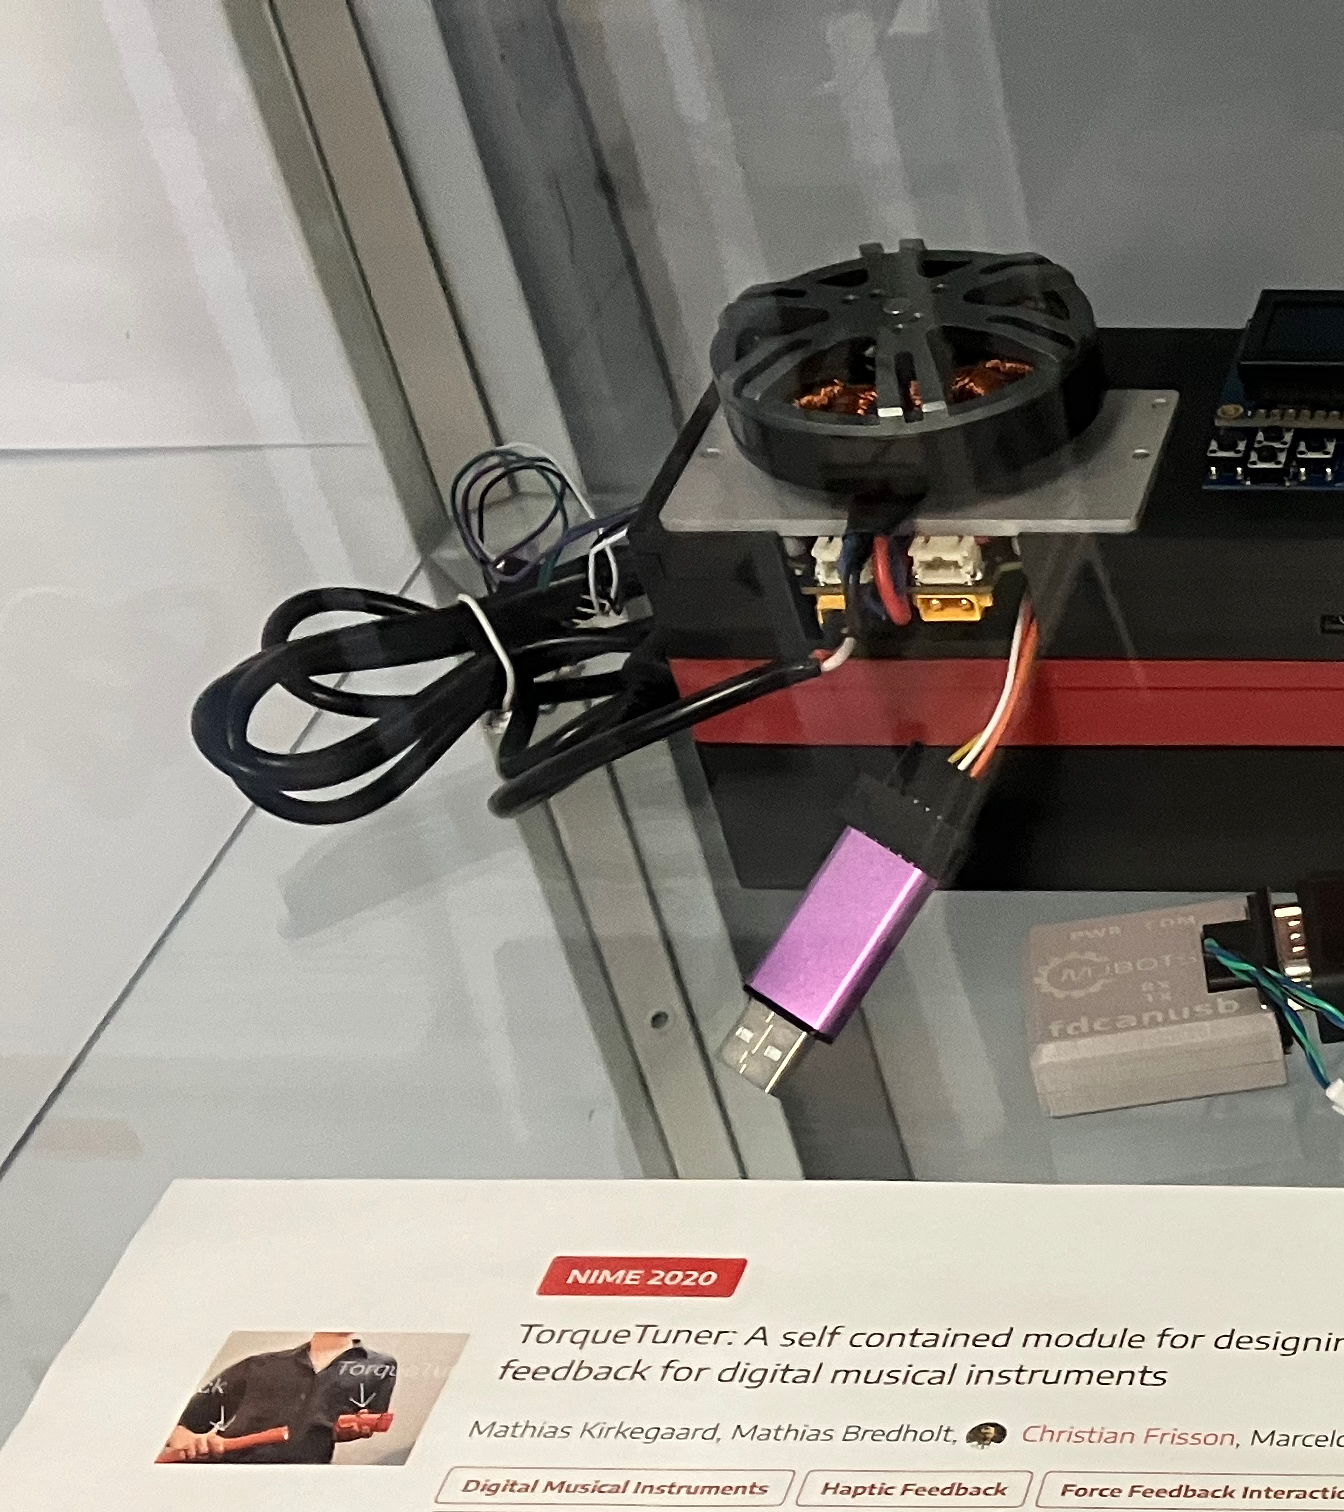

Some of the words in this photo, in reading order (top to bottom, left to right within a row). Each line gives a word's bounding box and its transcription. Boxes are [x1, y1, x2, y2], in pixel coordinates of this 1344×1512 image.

[1049, 998, 1240, 1038] fdcanusb
[566, 1269, 643, 1286] NIME
[647, 1269, 717, 1287] 2020
[519, 1324, 737, 1349] TorqueTuner:
[744, 1326, 769, 1346] A
[779, 1326, 842, 1348] self
[850, 1327, 1010, 1350] contained
[1021, 1327, 1145, 1350] module
[1157, 1328, 1205, 1350] for
[498, 1360, 648, 1382] feedback
[659, 1360, 703, 1382] for
[717, 1360, 822, 1389] digital
[829, 1363, 955, 1386] musical
[965, 1364, 1168, 1388] instruments
[469, 1421, 572, 1440] Mathias
[580, 1421, 722, 1445] Kirkegaard,
[732, 1422, 833, 1442] Mathias
[841, 1423, 958, 1446] Bredholt,
[1022, 1426, 1136, 1446] Christian
[1143, 1427, 1241, 1449] Frisson,
[462, 1479, 536, 1497] Digital
[541, 1479, 628, 1495] Musical
[633, 1480, 769, 1497] Instruments
[820, 1481, 894, 1500] Haptic
[900, 1482, 1008, 1498] Feedback
[1061, 1484, 1124, 1499] Force
[1128, 1484, 1236, 1499] Feedback
